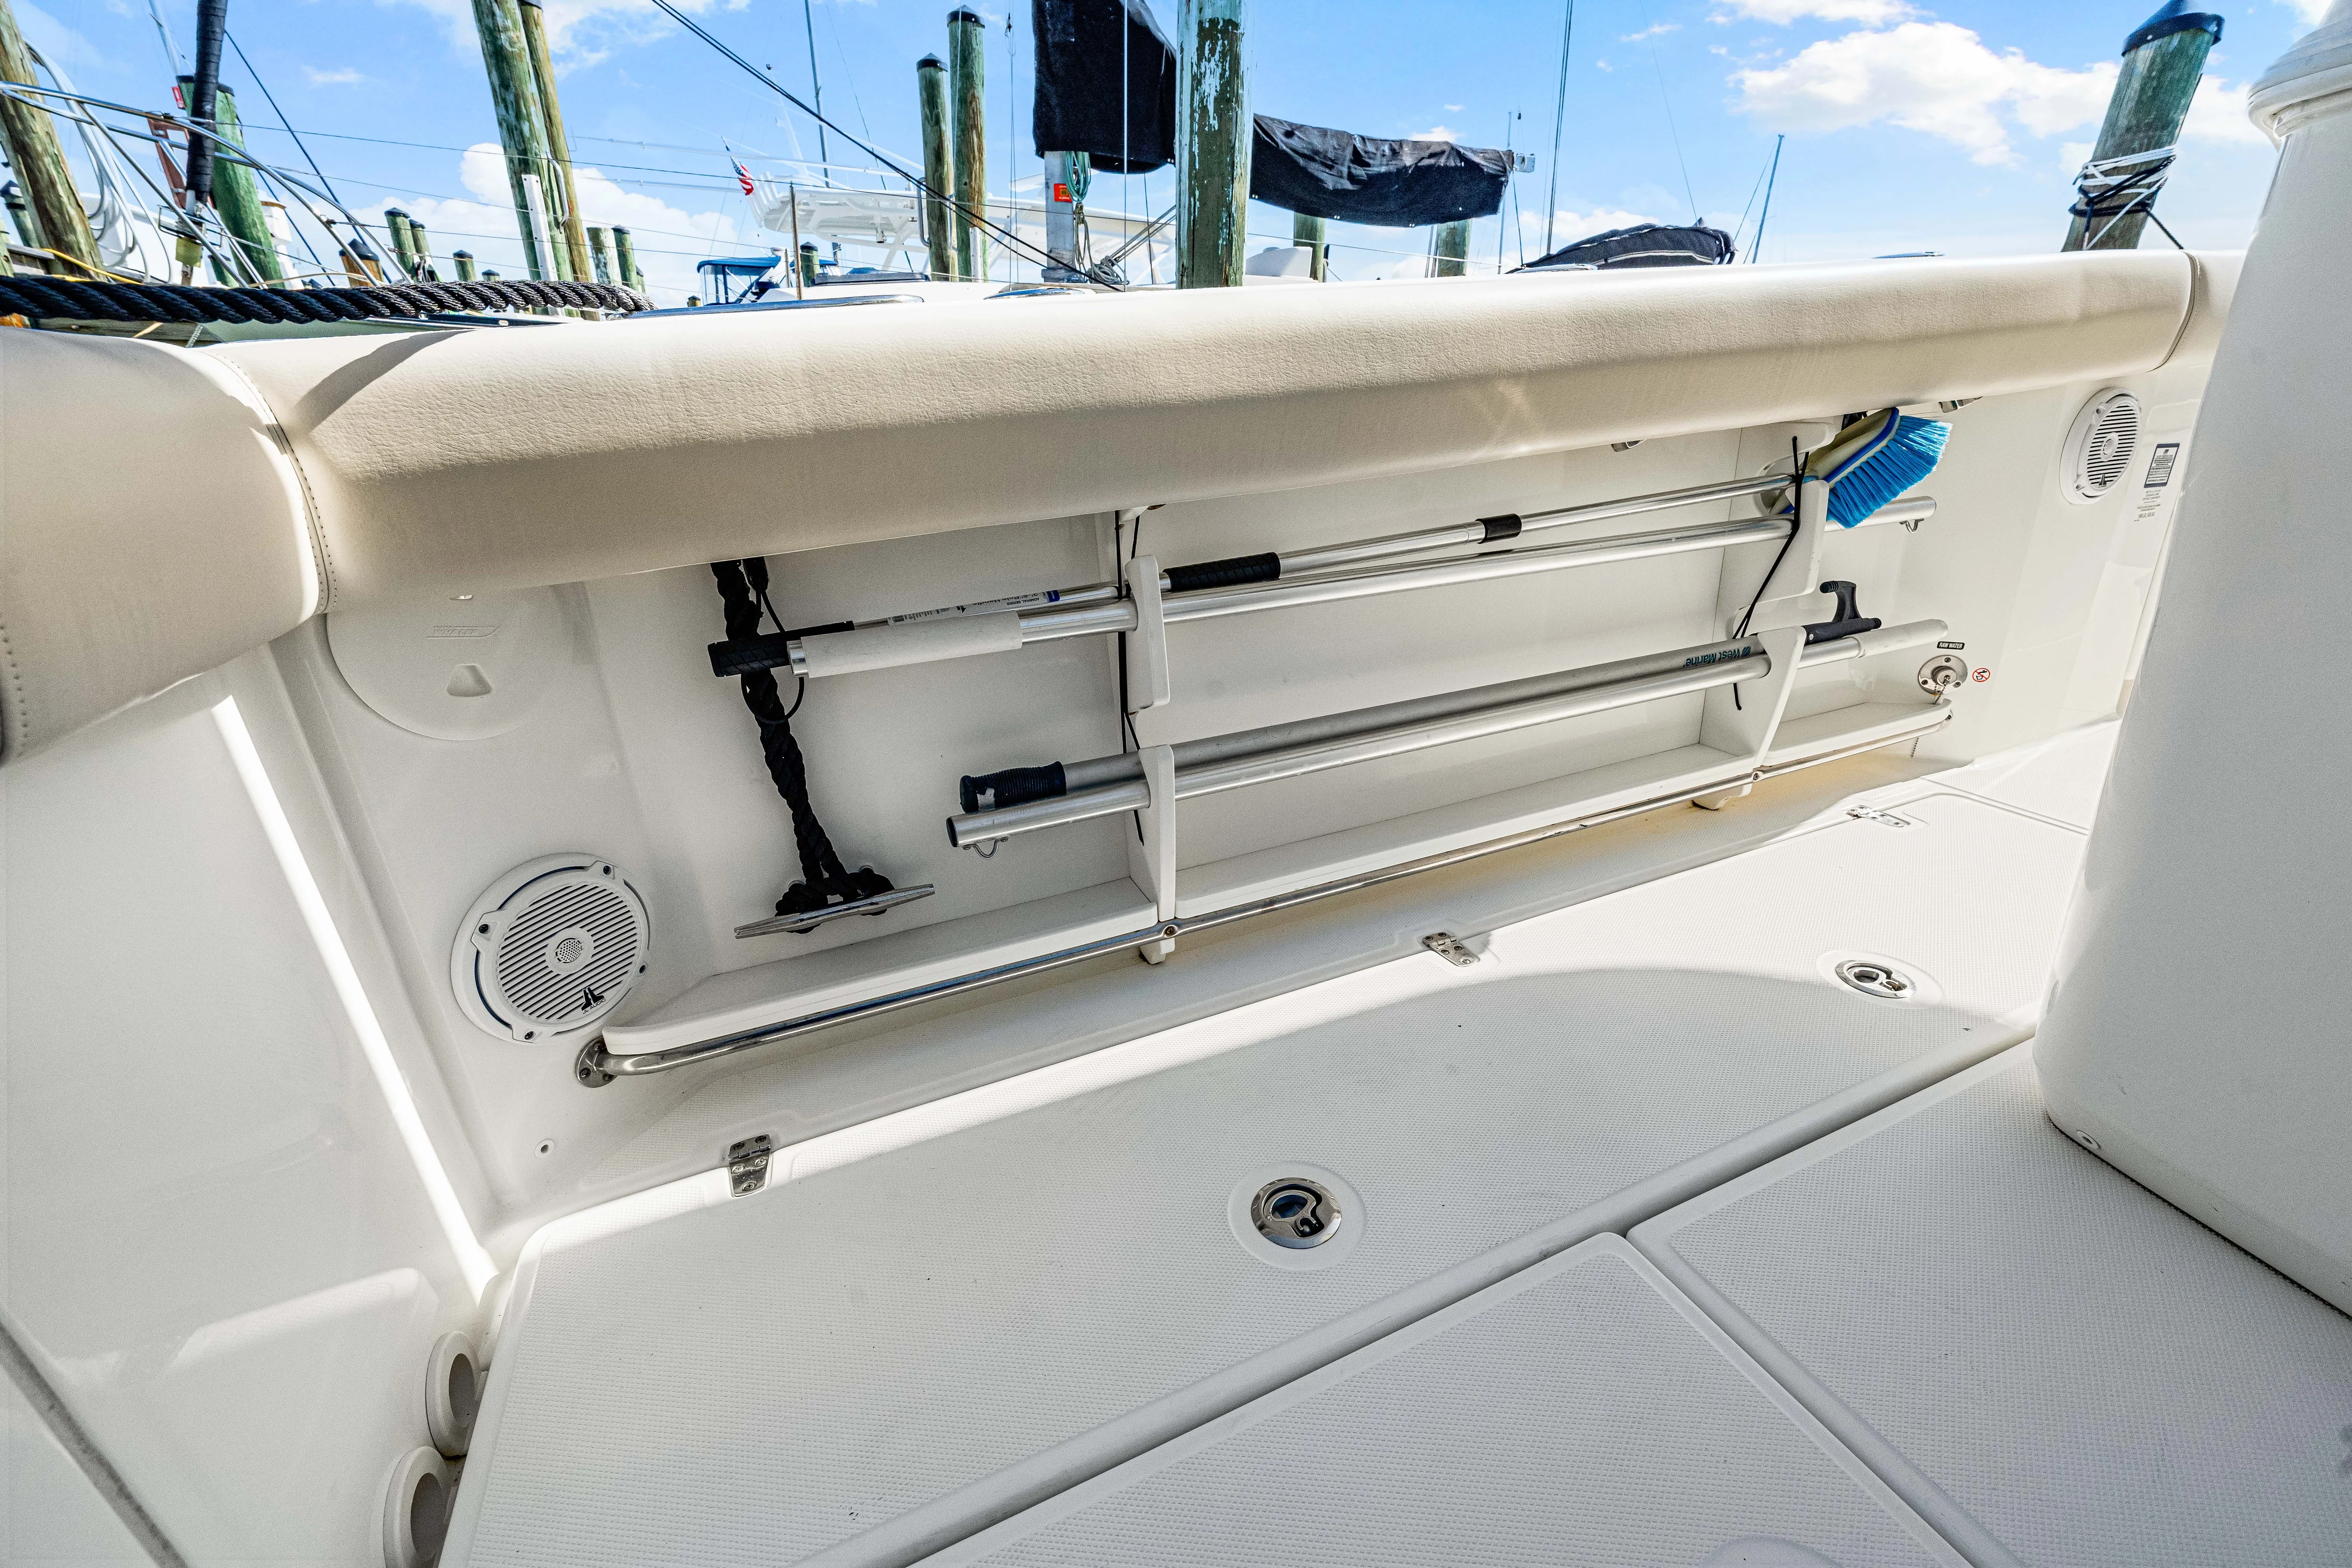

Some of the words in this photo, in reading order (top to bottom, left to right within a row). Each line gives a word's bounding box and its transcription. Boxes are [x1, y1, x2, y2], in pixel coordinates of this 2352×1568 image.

[1686, 653, 1717, 667] Marine
[1718, 648, 1740, 661] West
[590, 998, 606, 1010] AUDIO
